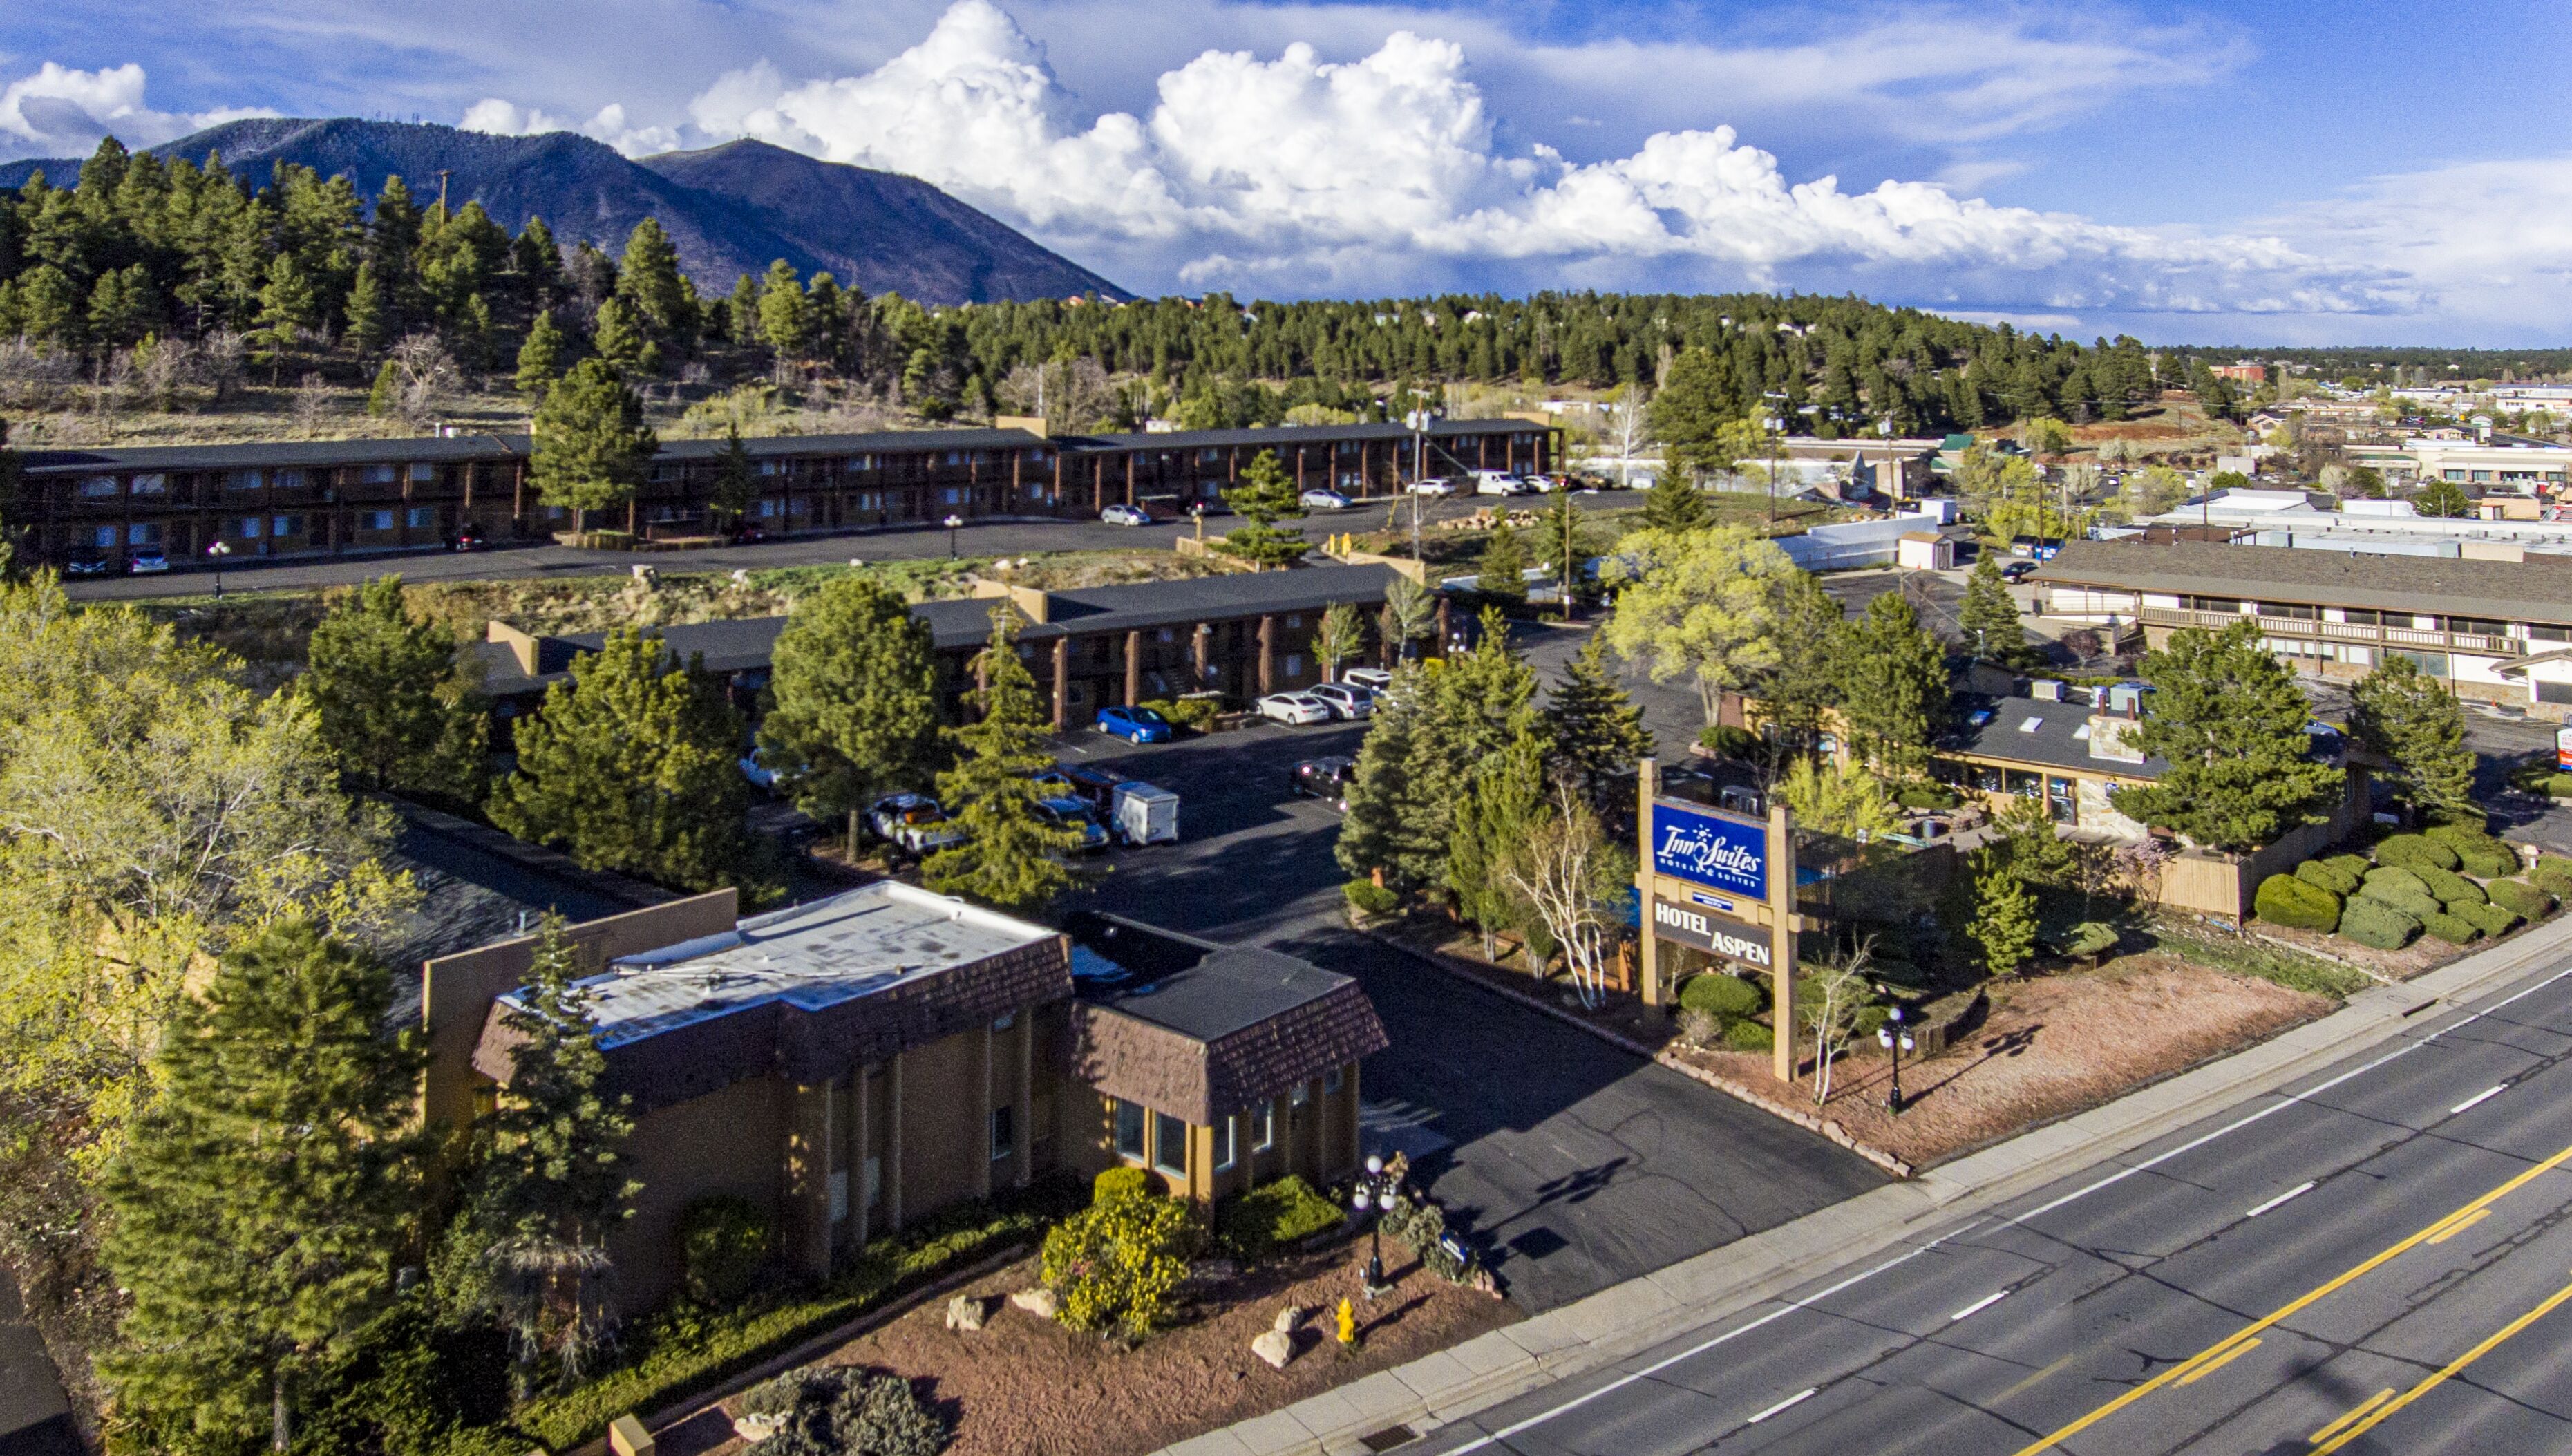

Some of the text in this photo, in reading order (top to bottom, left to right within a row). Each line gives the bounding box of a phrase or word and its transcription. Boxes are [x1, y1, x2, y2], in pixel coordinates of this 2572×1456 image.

[1659, 858, 1701, 873] HOTELS
[1717, 871, 1756, 887] SUITES
[1655, 902, 1770, 965] HOTEL ASPEN
